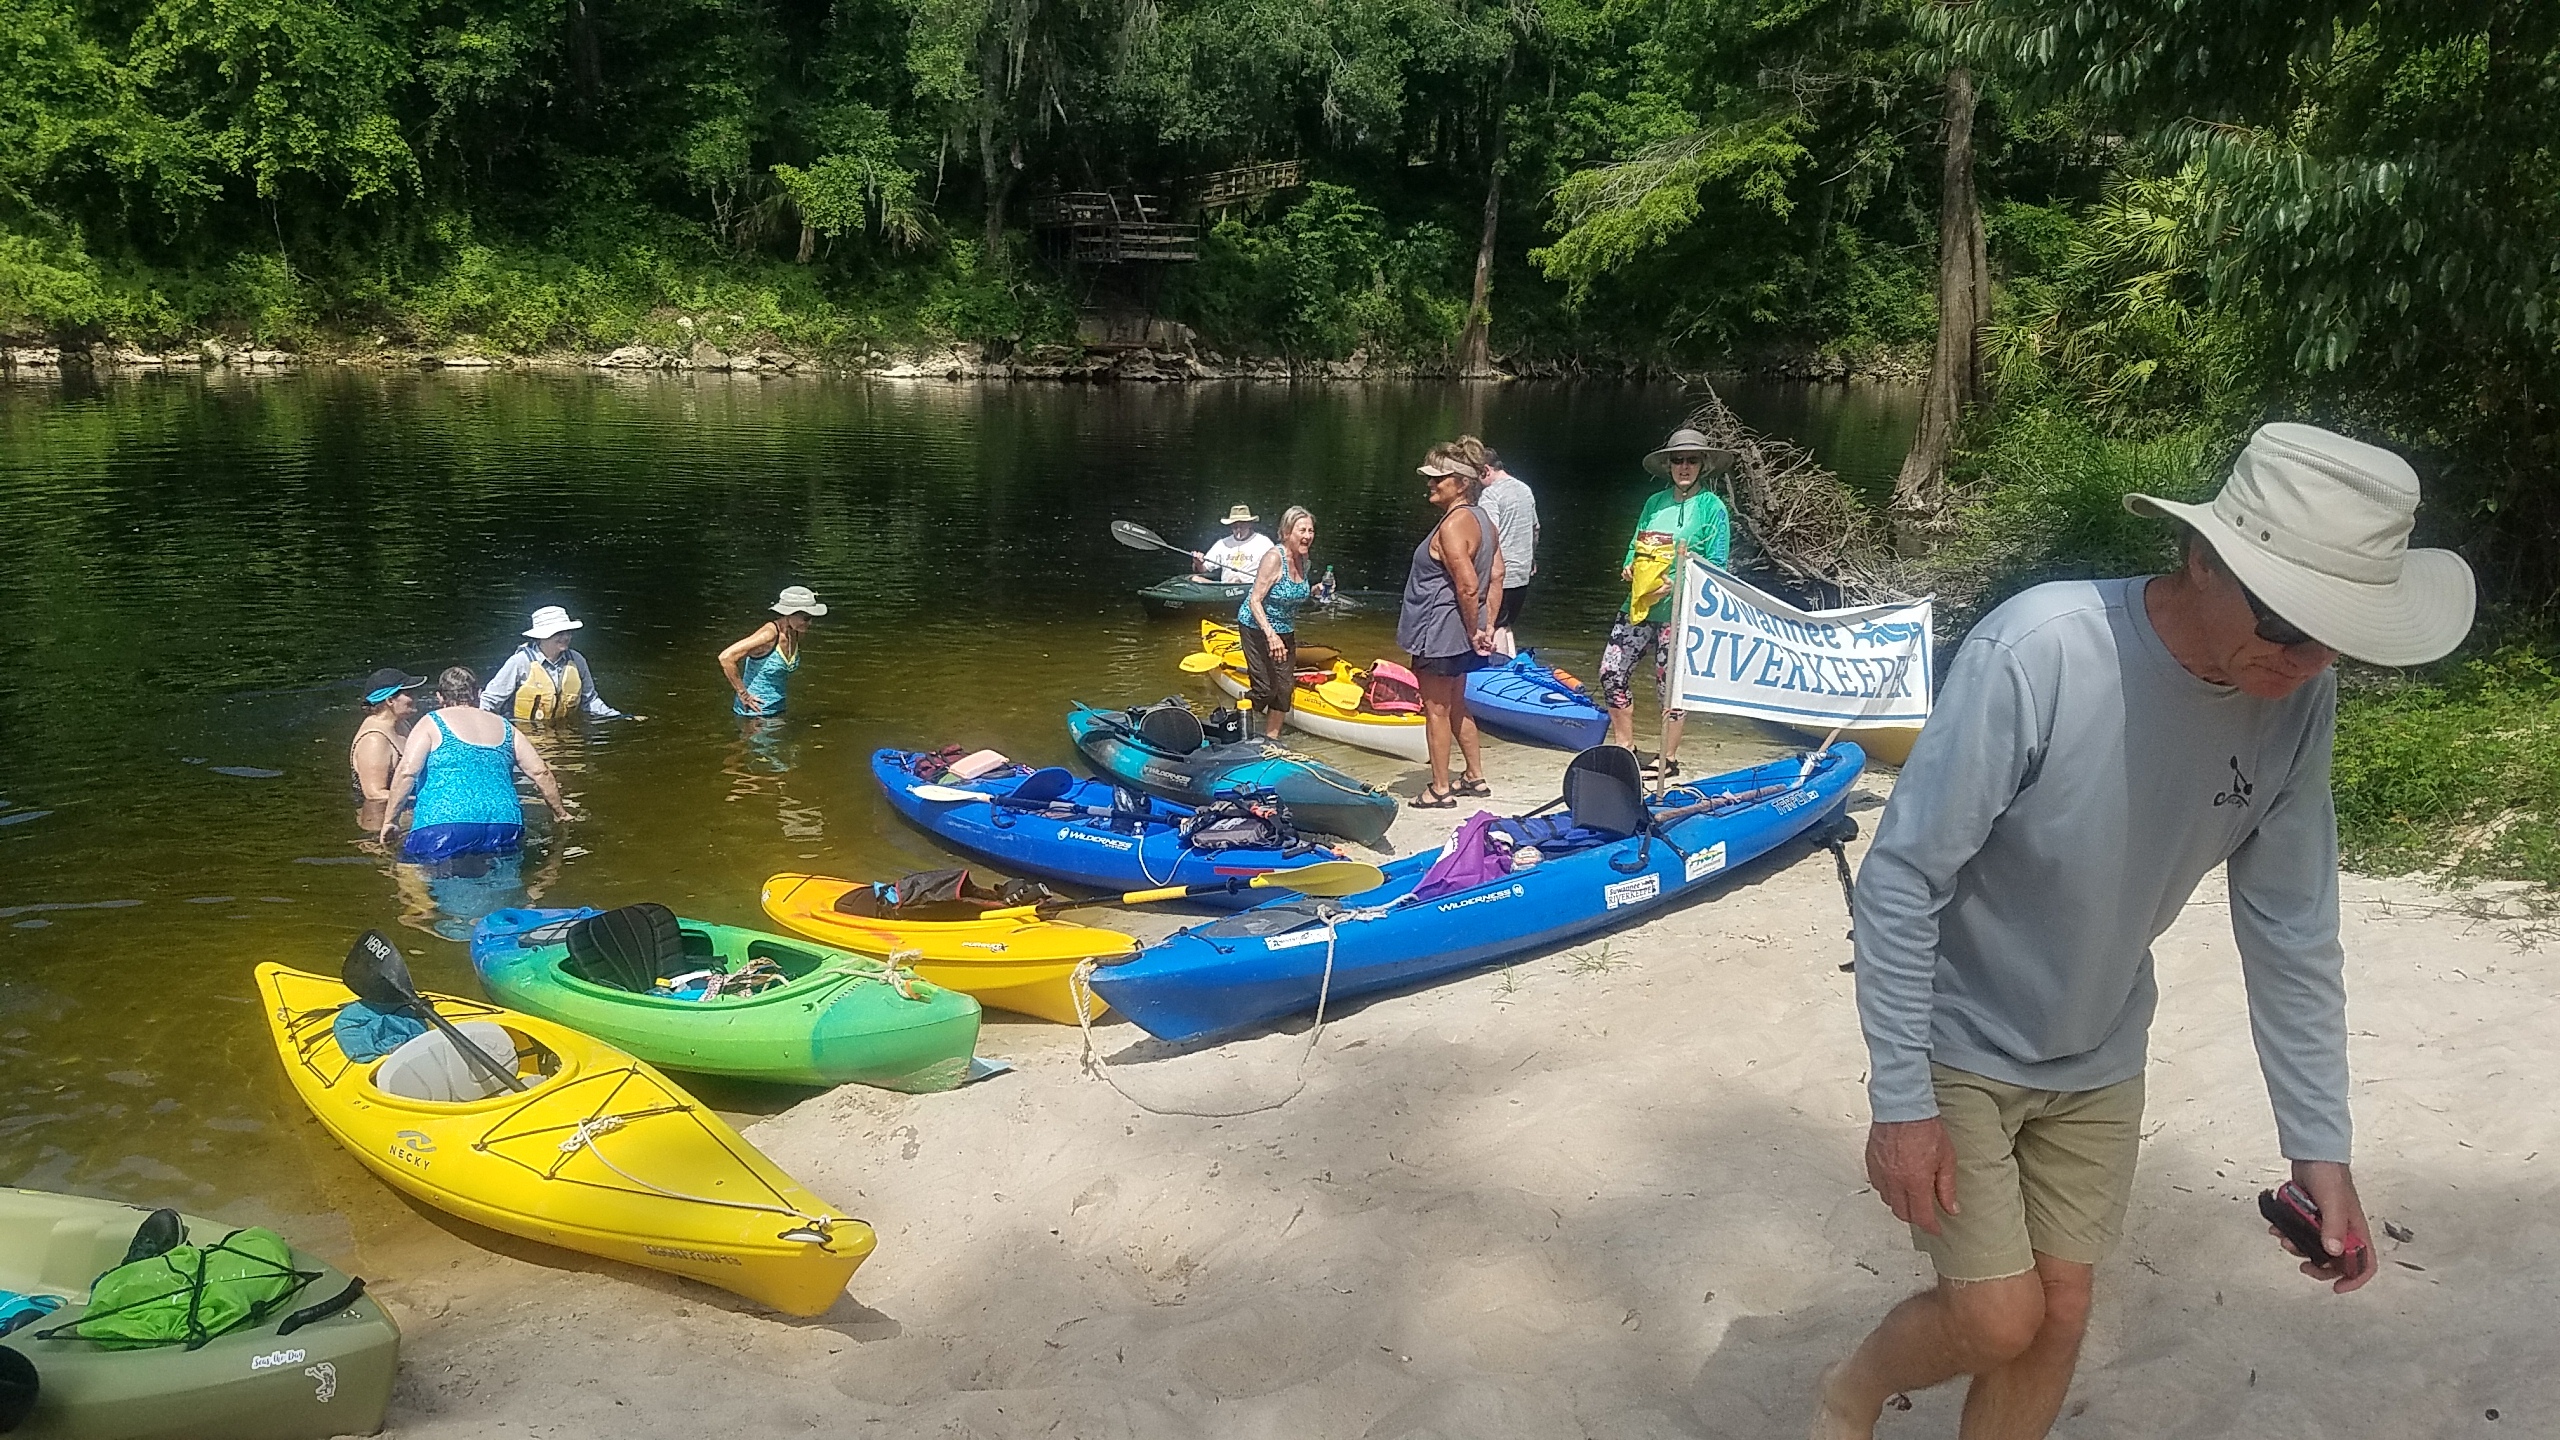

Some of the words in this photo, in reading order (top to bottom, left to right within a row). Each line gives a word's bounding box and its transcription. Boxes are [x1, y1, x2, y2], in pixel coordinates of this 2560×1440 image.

[1695, 578, 1841, 649] Suwannee
[1069, 831, 1133, 849] WILDERNESS
[1438, 888, 1511, 912] WILDERNESS
[1610, 883, 1640, 895] Suwannee
[389, 1144, 430, 1170] NECKY
